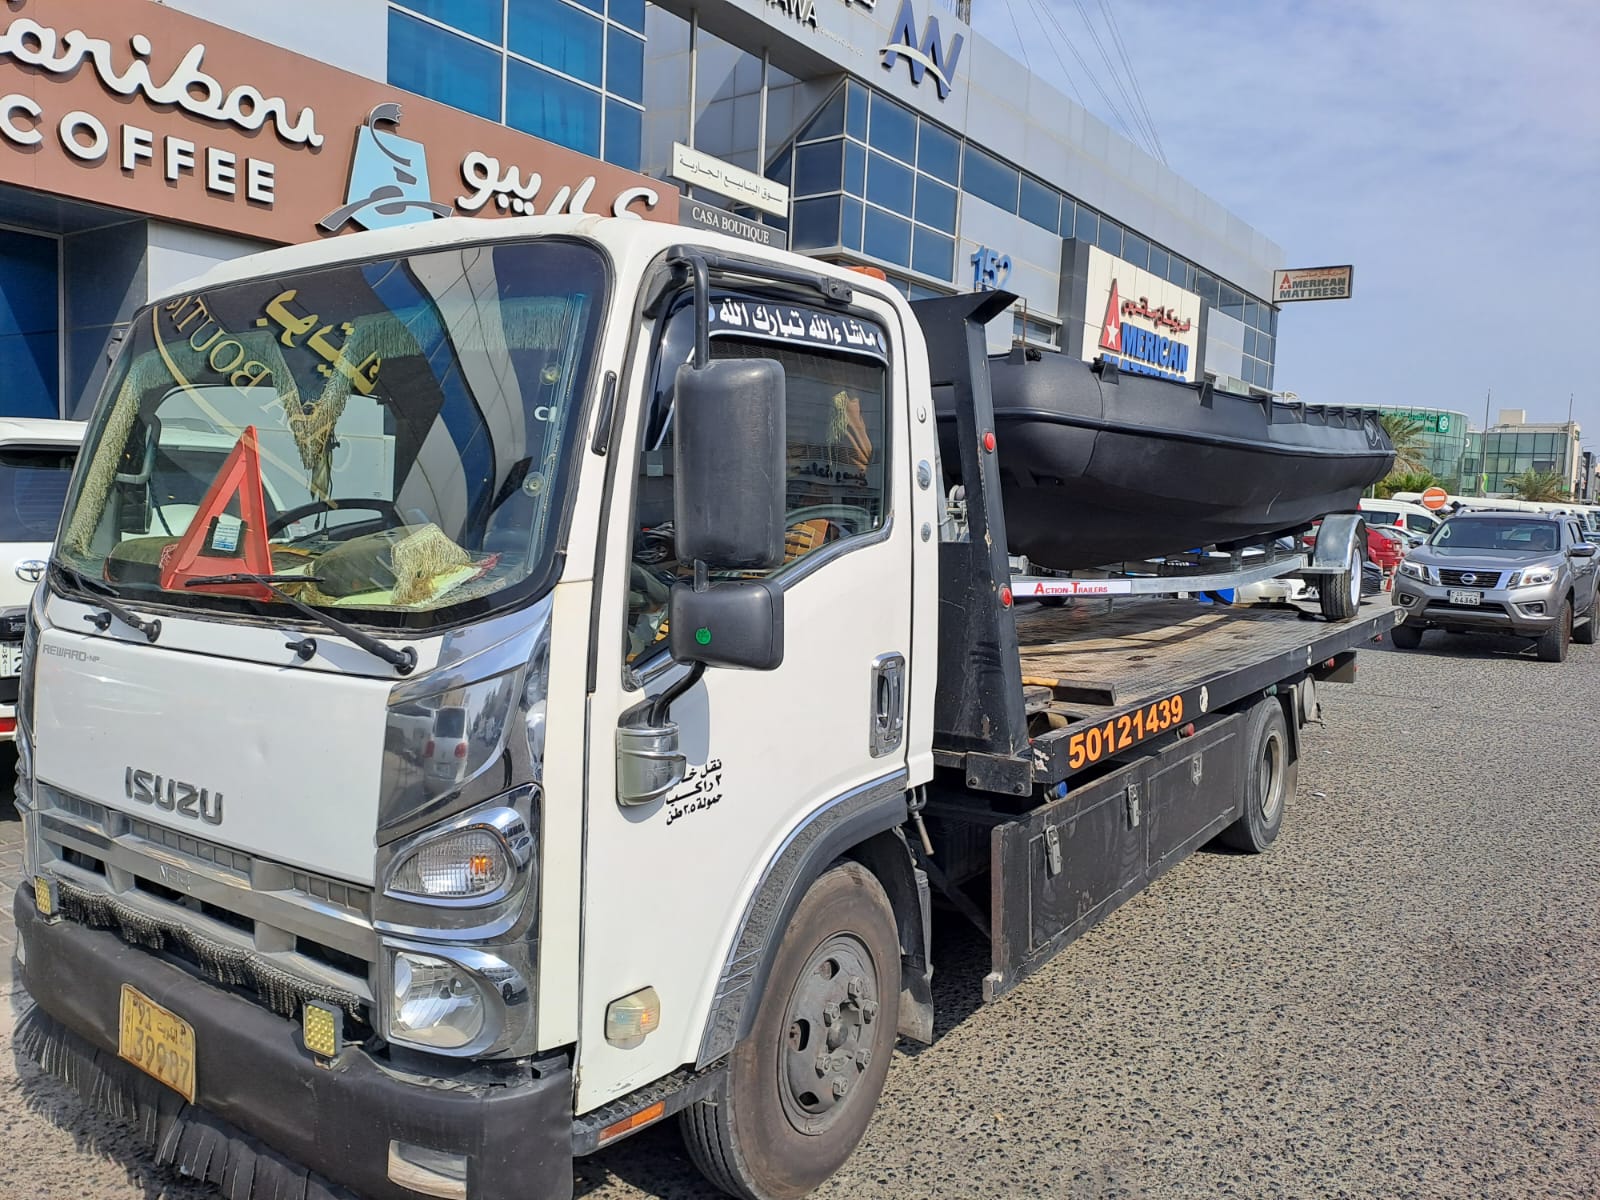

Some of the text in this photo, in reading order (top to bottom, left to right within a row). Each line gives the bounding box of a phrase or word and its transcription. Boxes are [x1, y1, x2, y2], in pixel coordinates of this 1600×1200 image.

[0, 18, 324, 147] aribou
[0, 93, 275, 204] COFFEE
[692, 206, 770, 244] CASA BOUTIQUE
[1279, 287, 1345, 299] MATTRESS
[1280, 272, 1346, 289] AMERICAN
[719, 298, 750, 327] الله
[1068, 694, 1184, 769] 50121439
[700, 759, 722, 779] نقل
[125, 766, 223, 826] ISUZU
[697, 794, 722, 810] حمولة
